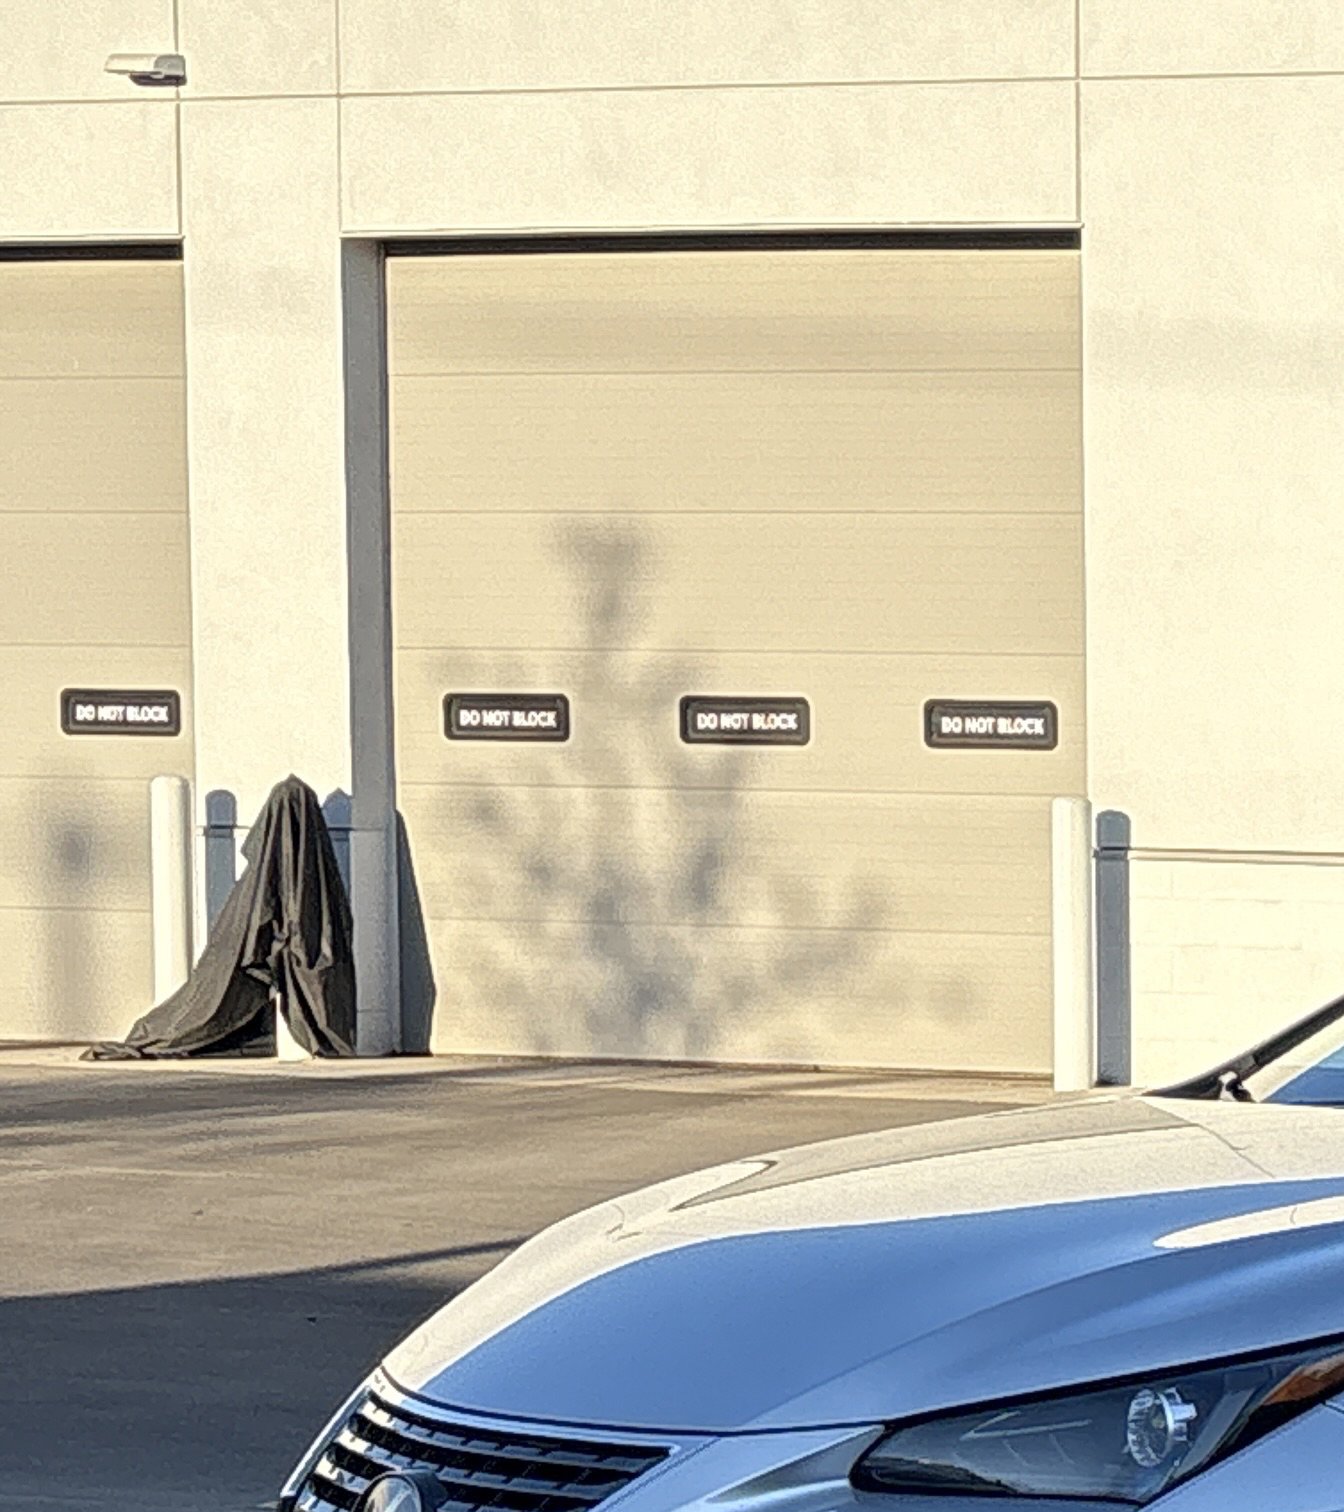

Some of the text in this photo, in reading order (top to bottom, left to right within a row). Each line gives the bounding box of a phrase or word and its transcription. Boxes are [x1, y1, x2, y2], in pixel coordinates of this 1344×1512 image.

[76, 704, 168, 722] DO NOT BLOCK
[460, 709, 557, 727] DO NOT BLOCK
[697, 713, 798, 730] DO NOT BLOCK
[941, 716, 1044, 735] DO NOT BLOCK
